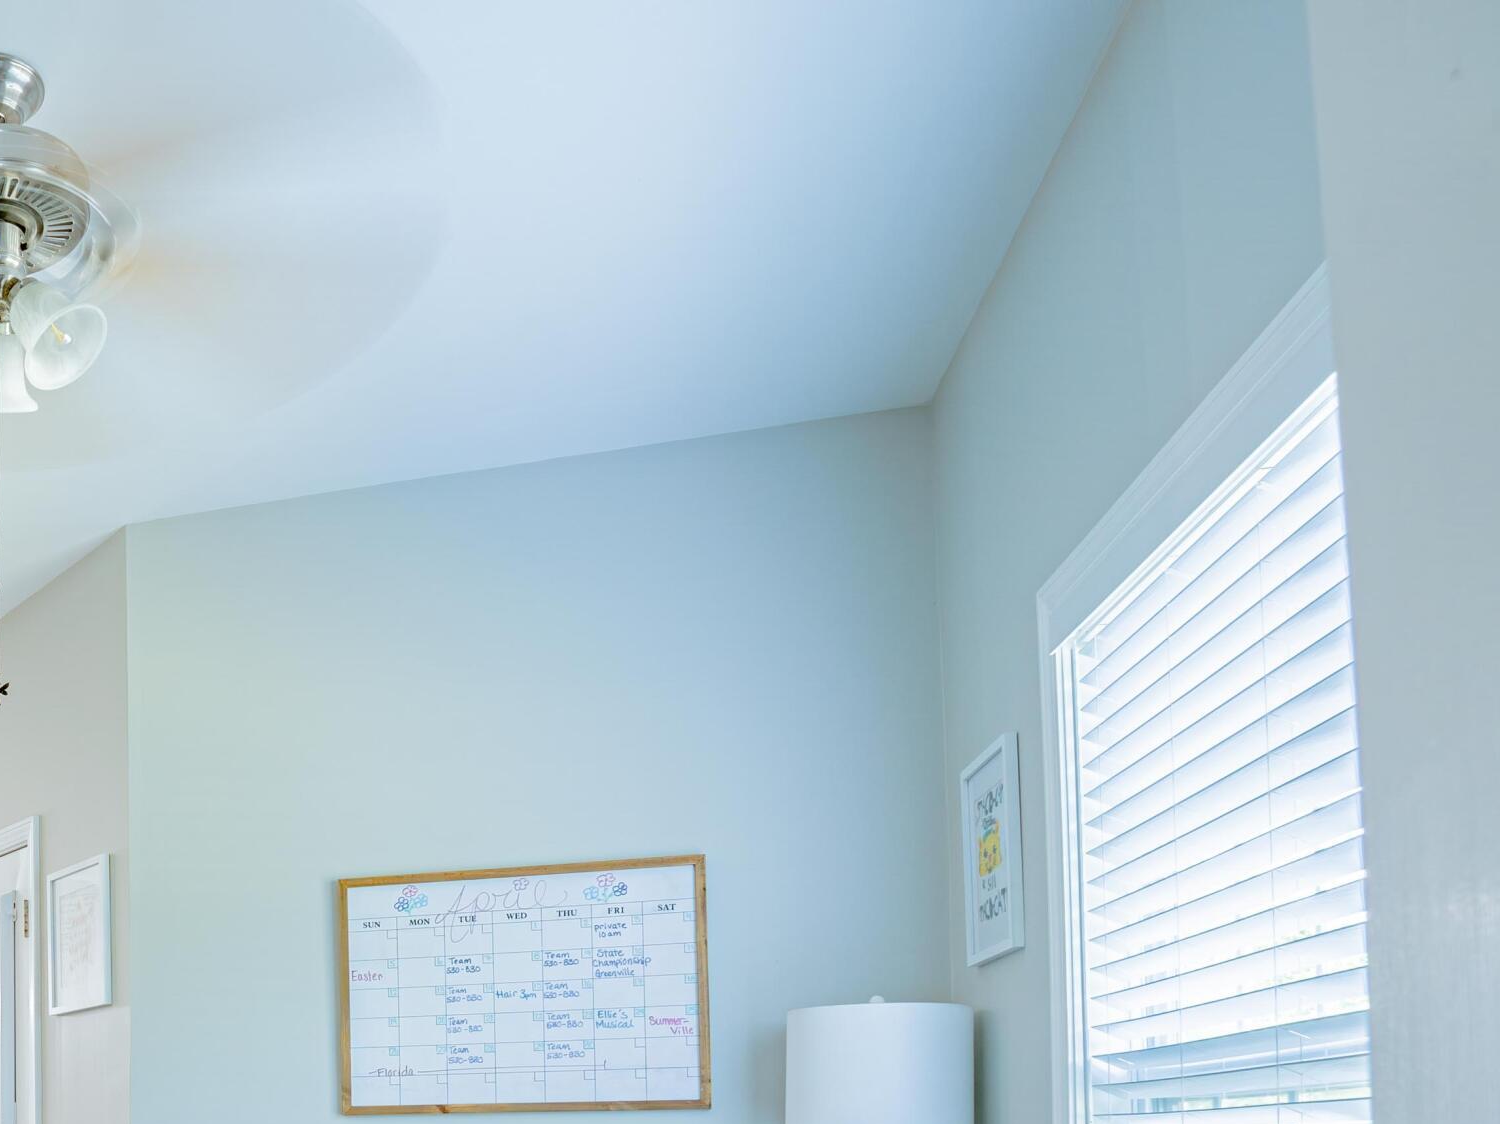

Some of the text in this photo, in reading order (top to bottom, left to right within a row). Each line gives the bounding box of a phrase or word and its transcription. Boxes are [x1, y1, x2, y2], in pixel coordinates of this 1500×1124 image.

[409, 918, 430, 926] MON
[458, 915, 477, 923] TUE
[506, 912, 528, 920] WED
[556, 909, 578, 918] THU
[657, 903, 676, 911] SAT
[435, 879, 568, 943] April
[594, 921, 628, 932] private
[592, 958, 651, 968] Championship
[351, 970, 383, 982] Easter
[595, 969, 635, 978] Greenville
[449, 987, 467, 995] Team
[545, 982, 568, 990] Team
[496, 989, 536, 999] Hair 3pm
[598, 1010, 628, 1019] Ellie's
[595, 1019, 634, 1029] Musical
[670, 1026, 694, 1035] Ville
[377, 1065, 414, 1077] Florida
